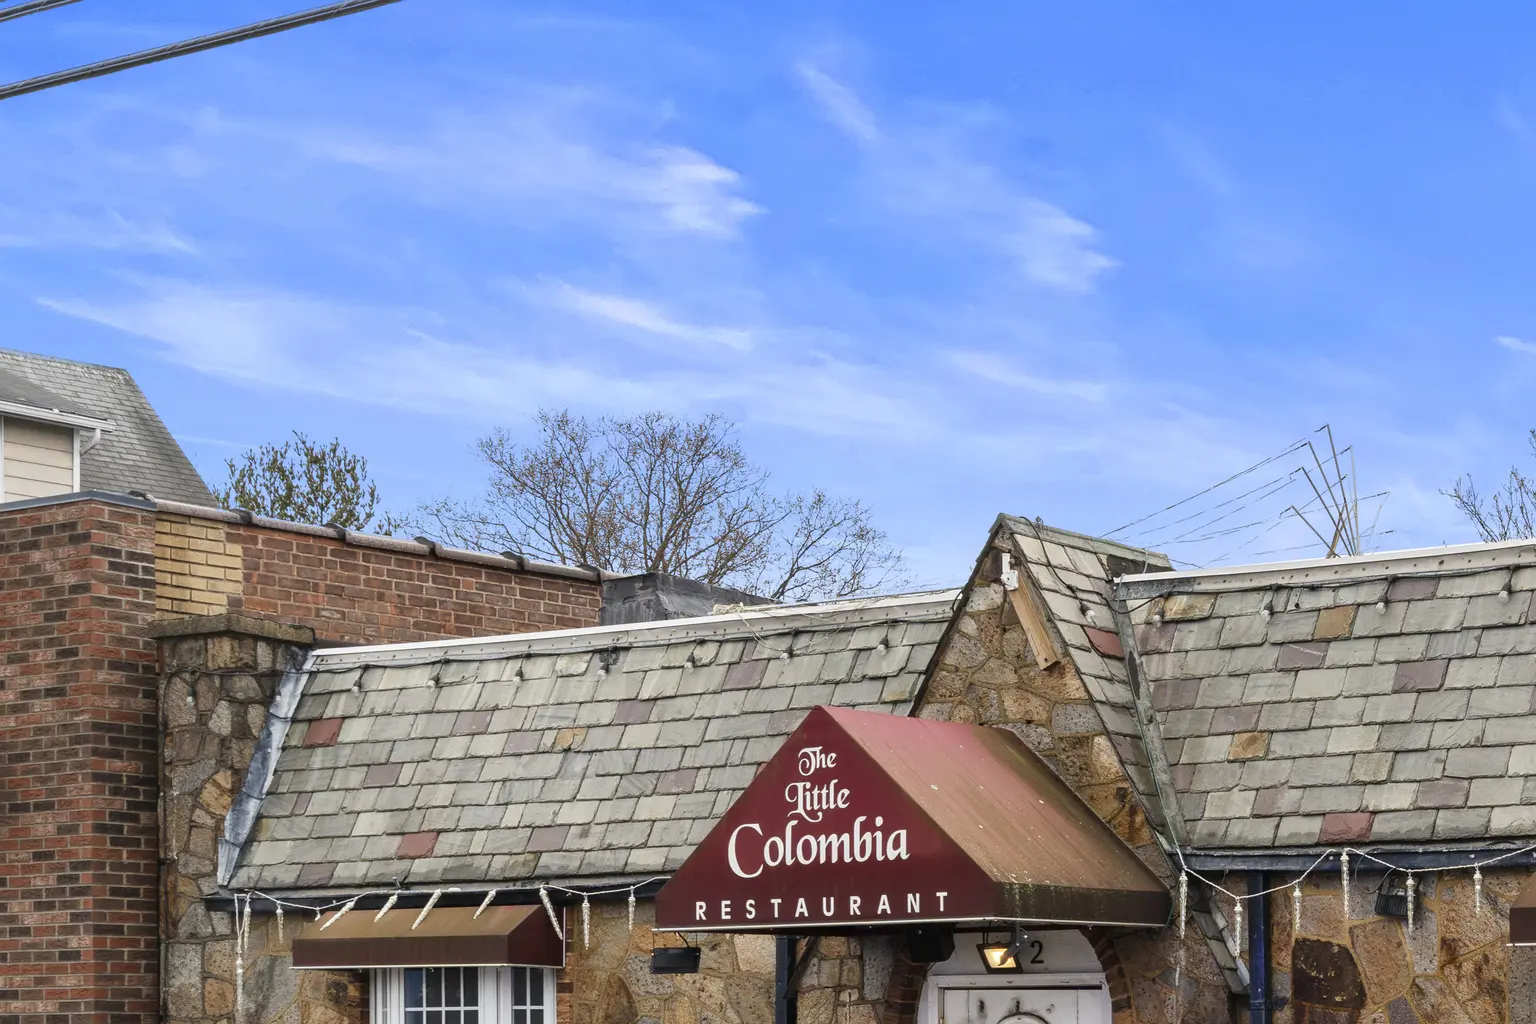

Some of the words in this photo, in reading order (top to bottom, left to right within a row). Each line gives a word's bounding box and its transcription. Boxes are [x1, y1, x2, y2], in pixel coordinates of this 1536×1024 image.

[798, 746, 837, 777] The
[785, 779, 850, 823] Little
[727, 815, 910, 879] Colombia
[695, 891, 949, 921] RESTAURANT
[1030, 940, 1044, 964] 2
